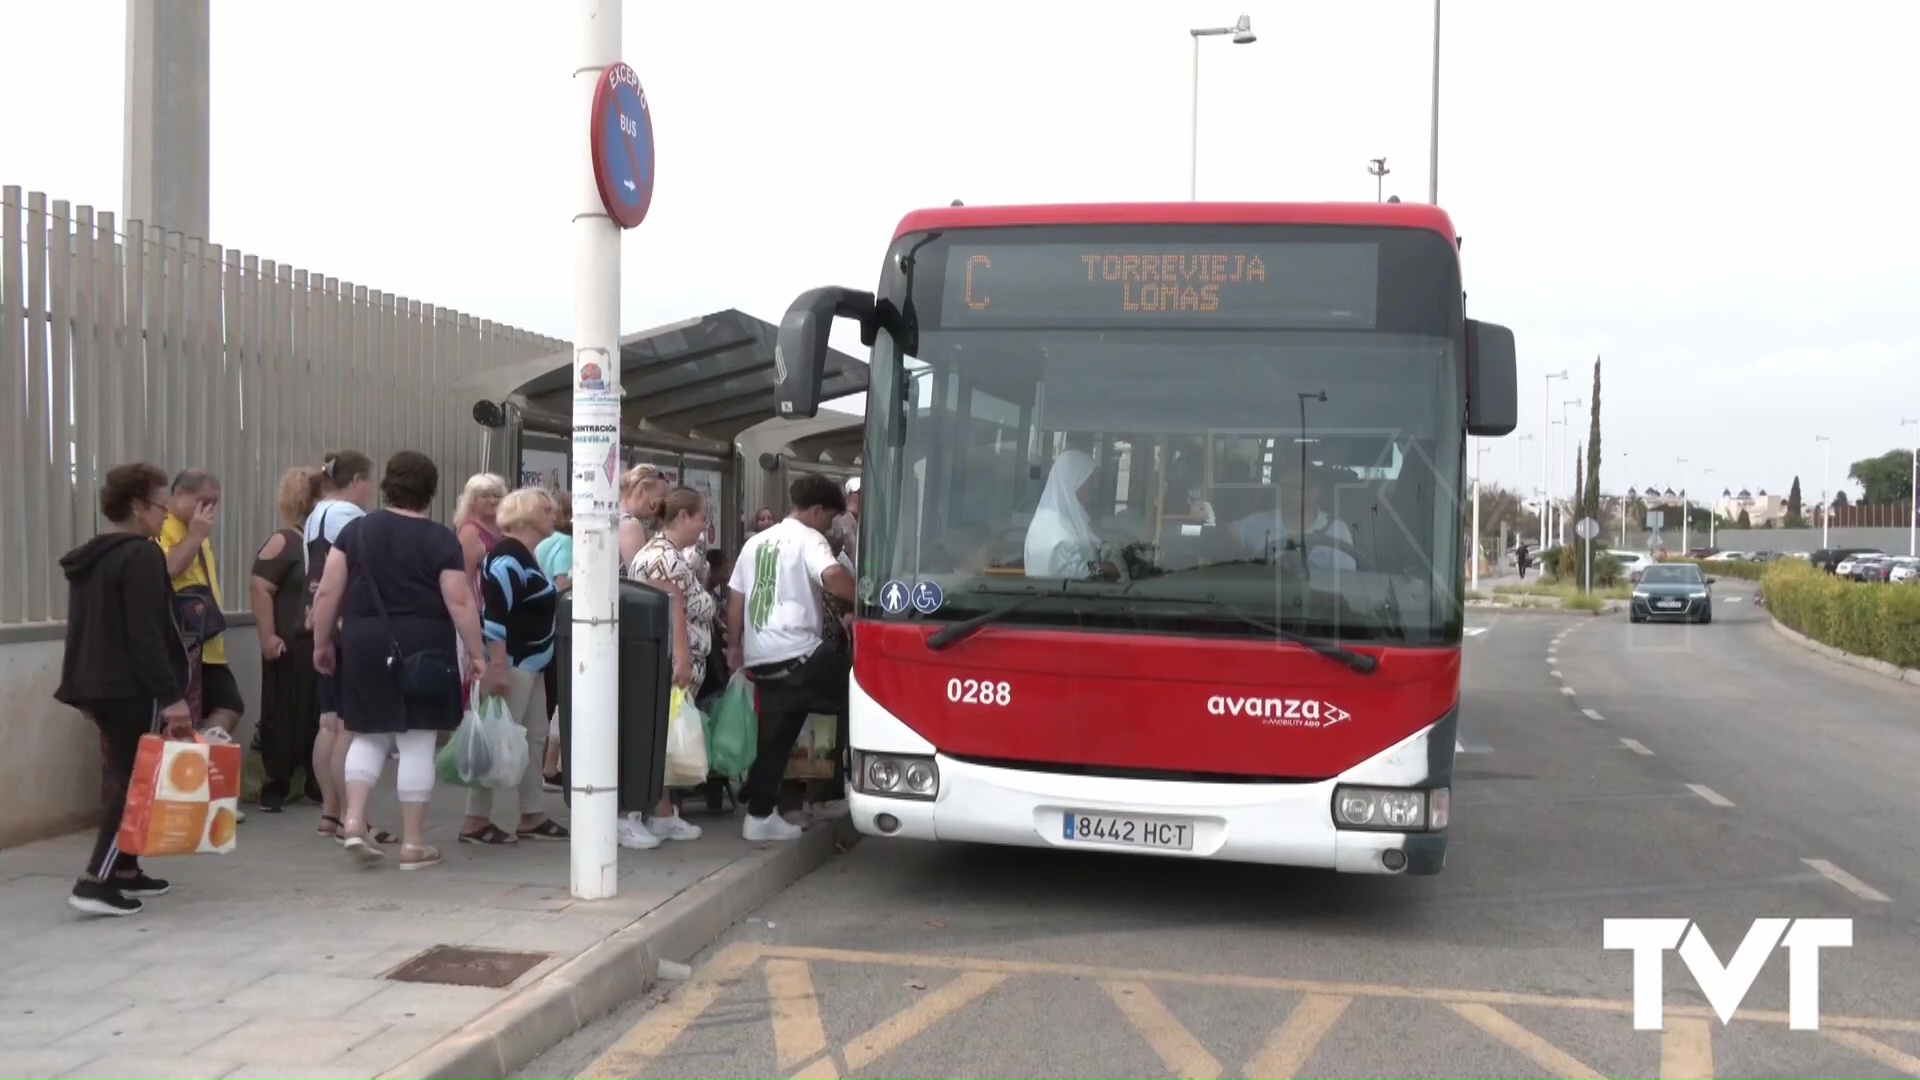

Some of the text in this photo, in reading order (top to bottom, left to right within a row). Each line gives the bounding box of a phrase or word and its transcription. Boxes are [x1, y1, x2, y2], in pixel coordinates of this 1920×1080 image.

[609, 65, 647, 111] EXCEPTO
[620, 114, 637, 138] BUS
[965, 254, 991, 310] C
[1082, 254, 1266, 282] TORREVIEJA
[1123, 283, 1220, 312] LOMAS
[947, 677, 1011, 706] 0288
[1207, 695, 1320, 719] avanza
[1079, 817, 1187, 846] 8442 HCT
